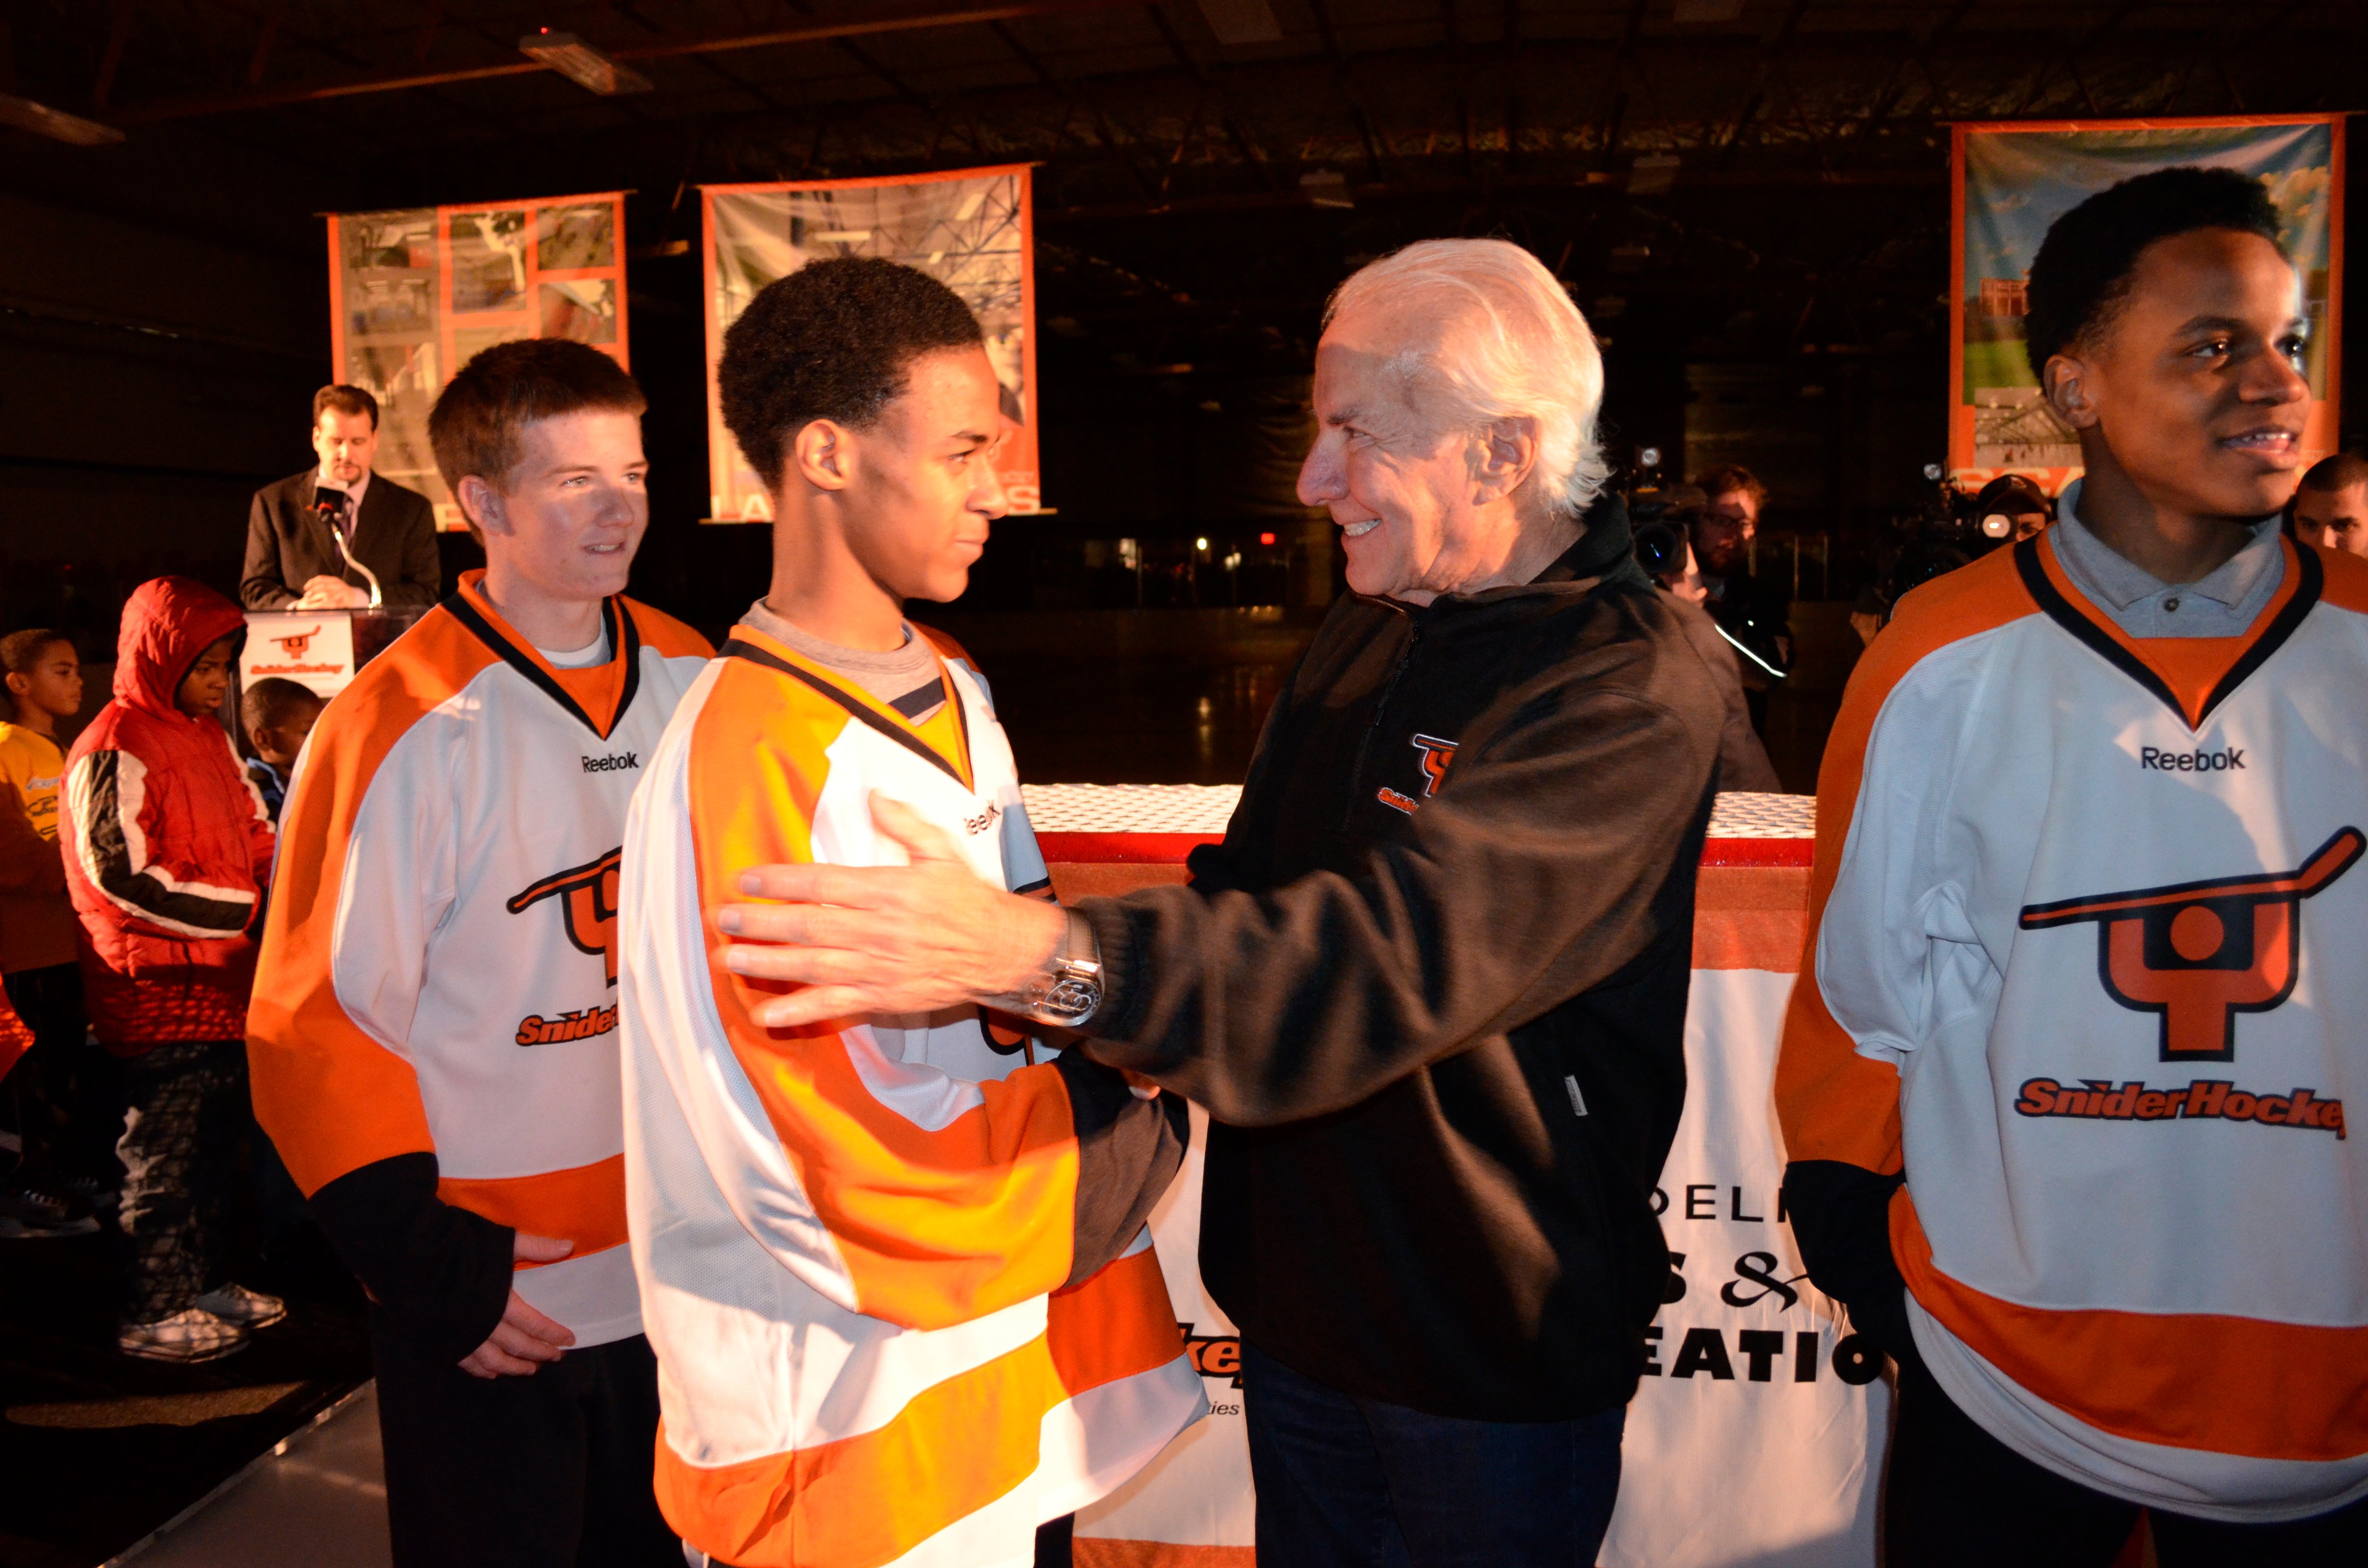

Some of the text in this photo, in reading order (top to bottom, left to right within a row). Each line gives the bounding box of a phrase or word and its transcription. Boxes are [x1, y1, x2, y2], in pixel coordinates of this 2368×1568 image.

[581, 752, 639, 772] Reebok
[2142, 747, 2245, 772] Reebok
[2015, 1077, 2346, 1140] SniderHocke
[1721, 1251, 1809, 1313] &
